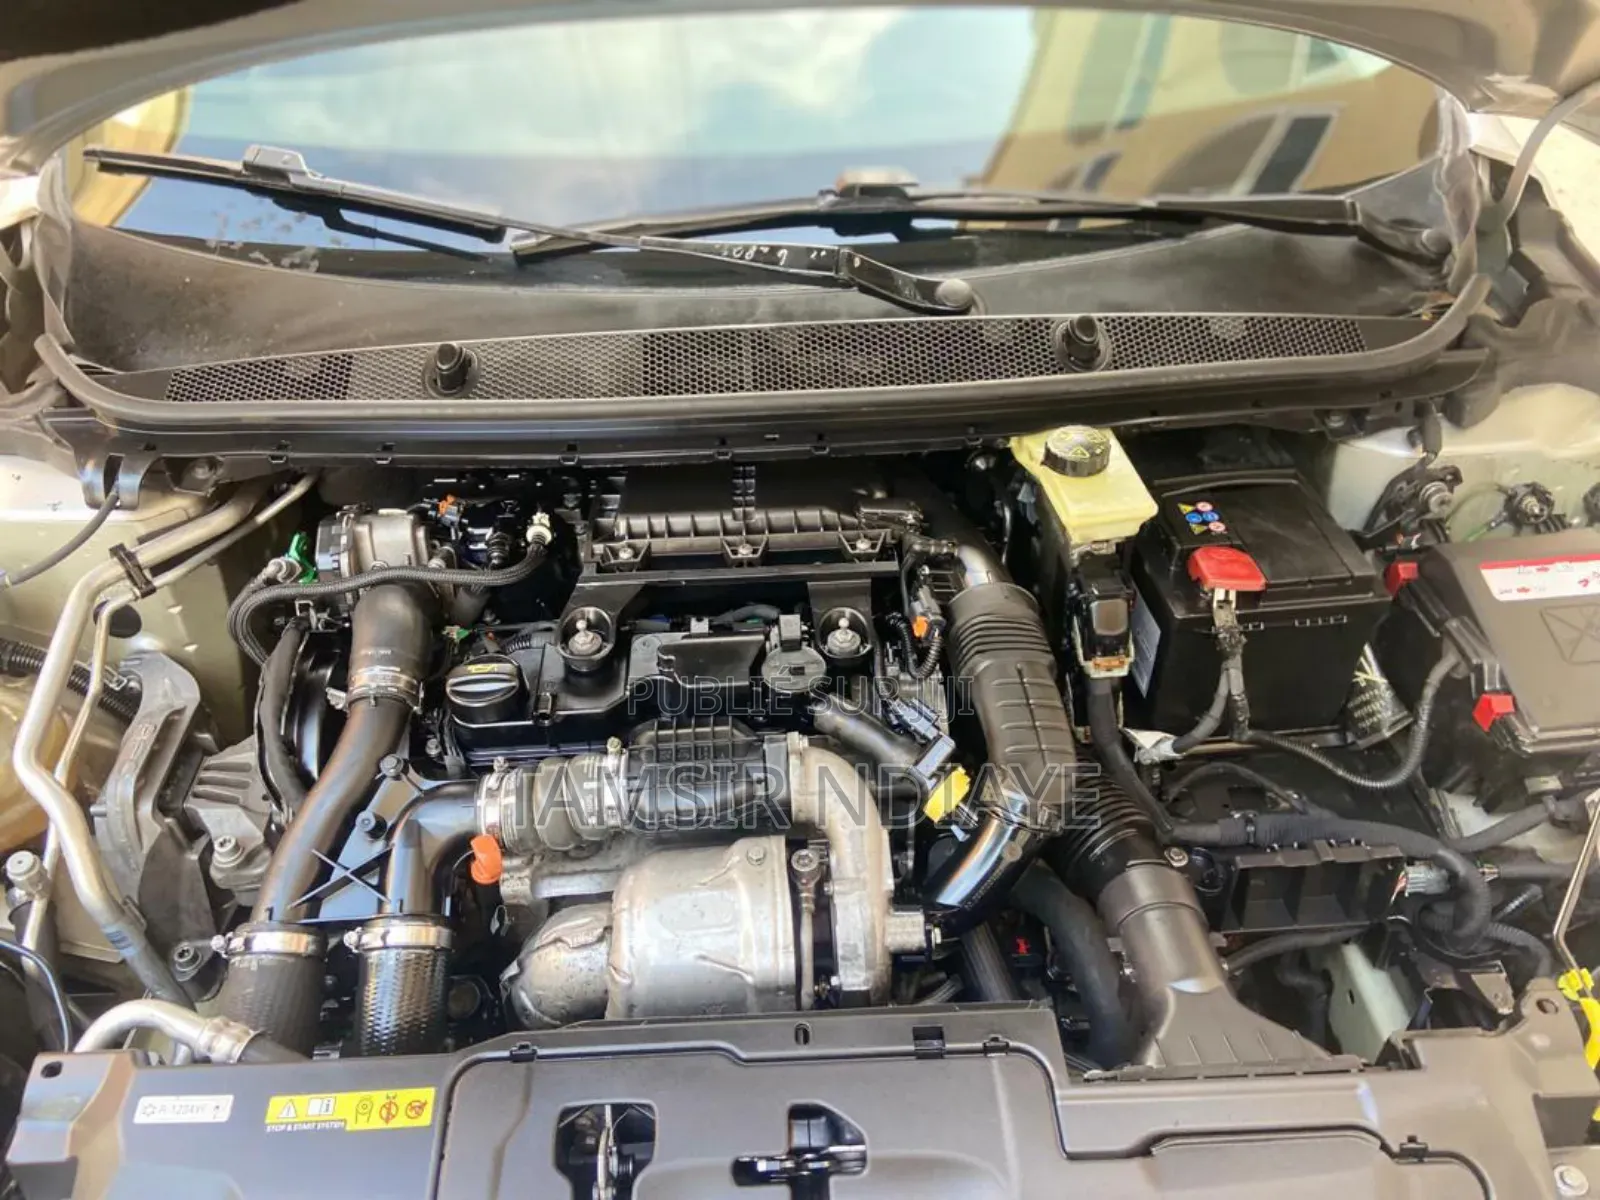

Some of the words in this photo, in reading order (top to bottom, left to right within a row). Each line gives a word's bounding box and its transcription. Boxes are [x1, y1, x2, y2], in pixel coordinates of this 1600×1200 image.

[266, 1123, 285, 1133] STOP
[294, 1122, 316, 1132] START
[317, 1120, 345, 1131] SYSTEM
